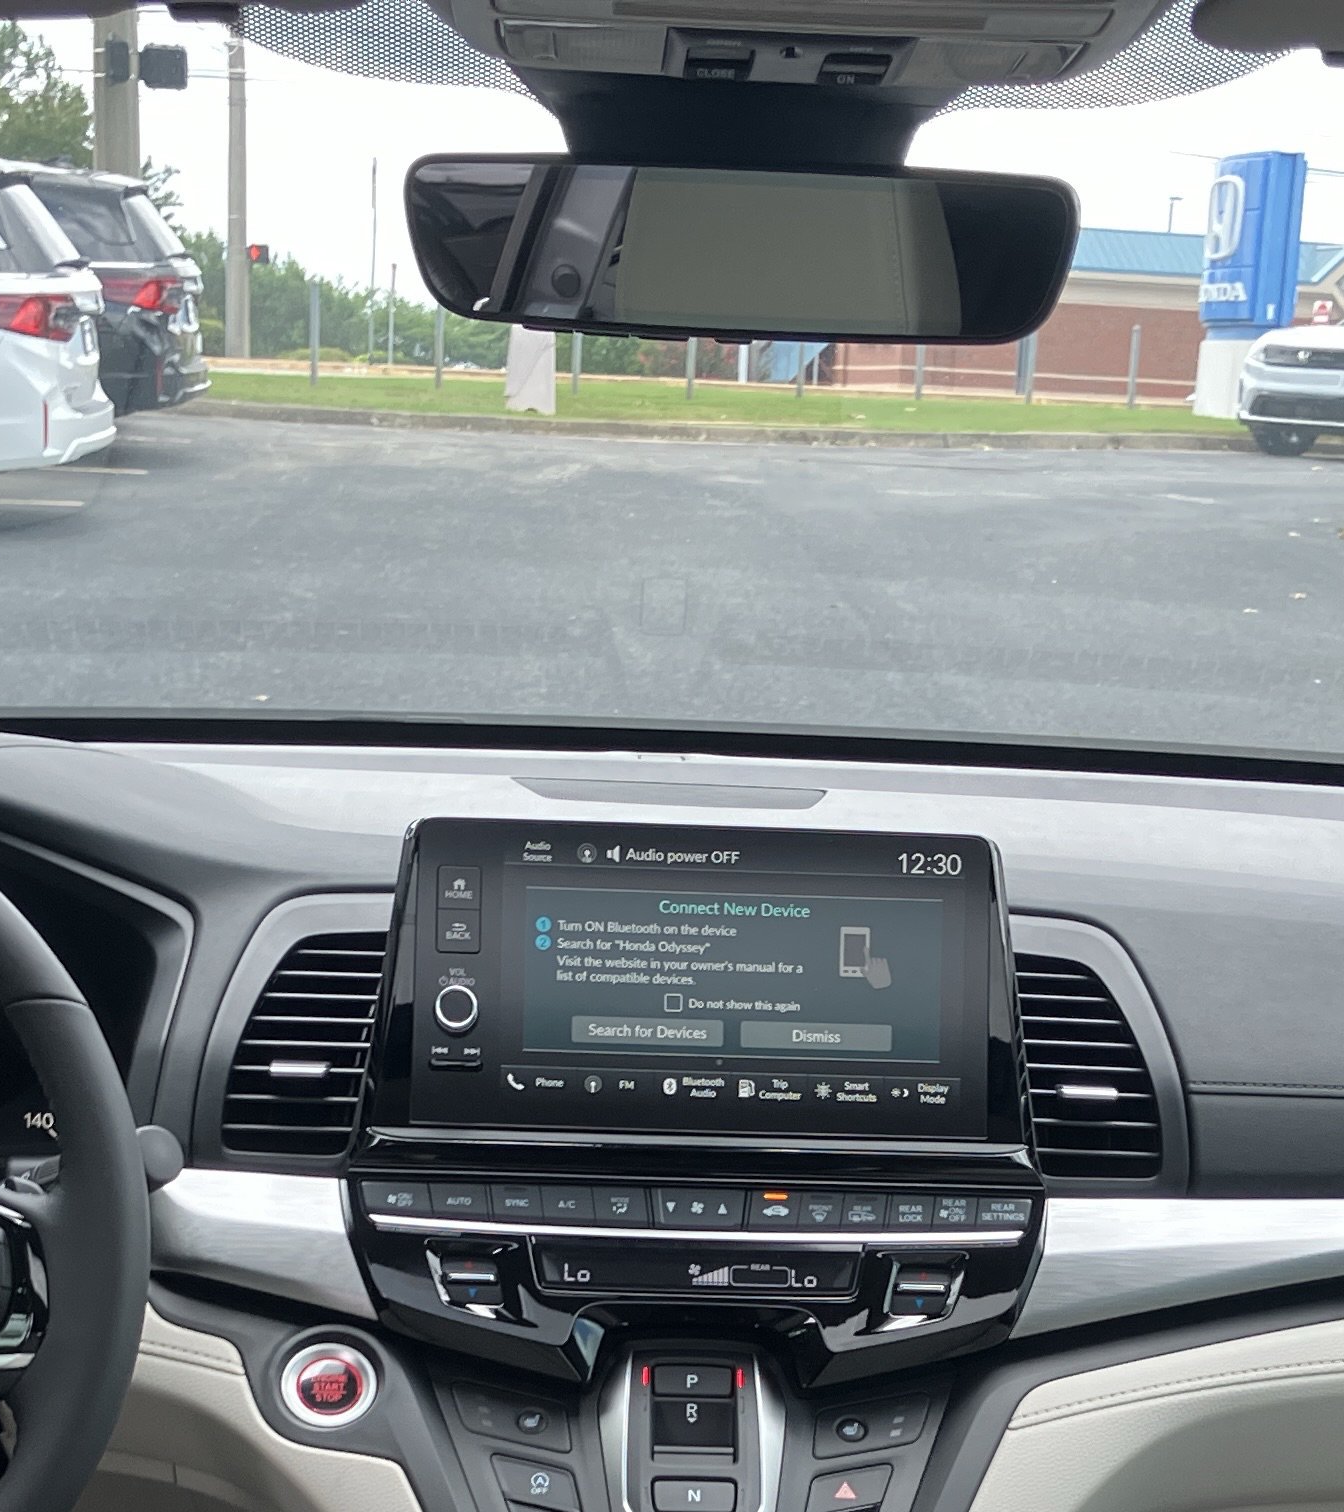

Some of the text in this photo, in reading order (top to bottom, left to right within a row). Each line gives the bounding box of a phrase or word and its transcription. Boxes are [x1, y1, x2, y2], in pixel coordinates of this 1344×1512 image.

[696, 68, 735, 79] CLOSE
[836, 75, 855, 85] ON
[525, 841, 552, 851] Audio
[523, 852, 553, 863] Source
[625, 847, 741, 865] Audio power OFF
[897, 852, 963, 876] 12:30
[444, 890, 473, 900] HOME
[658, 900, 811, 918] Connect New Device
[557, 919, 737, 938] Turn ON Bluetooth on the device
[445, 931, 471, 941] BACK
[557, 937, 711, 955] Search for "Honda Odyssey"
[556, 955, 804, 974] Visit the website in your owner's manual for a
[556, 969, 697, 986] list of compatible devices.
[688, 998, 801, 1014] Do not show this again
[588, 1022, 707, 1041] Search for Devices
[792, 1028, 841, 1045] Dismiss
[535, 1076, 565, 1089] Phone
[618, 1079, 635, 1090] FM
[682, 1076, 725, 1088] Bluetooth
[772, 1078, 789, 1090] Trip
[843, 1080, 870, 1092] Smart
[689, 1087, 717, 1099] Audio
[917, 1082, 950, 1095] Display
[758, 1089, 802, 1102] Computer
[836, 1091, 878, 1103] Shortcuts
[919, 1094, 947, 1105] Mode
[23, 1111, 55, 1129] 140
[445, 1196, 473, 1206] AUTO
[505, 1198, 530, 1209] SYNC
[557, 1199, 577, 1210] A/C
[942, 1198, 967, 1208] REAR
[898, 1203, 923, 1214] REAR
[990, 1202, 1015, 1213] REAR
[898, 1212, 924, 1224] LOCK
[981, 1211, 1025, 1222] SETTINGS
[563, 1262, 591, 1283] Lo
[686, 1374, 699, 1388] P
[686, 1402, 699, 1416] R
[530, 1487, 549, 1495] OFF
[687, 1489, 702, 1503] N
